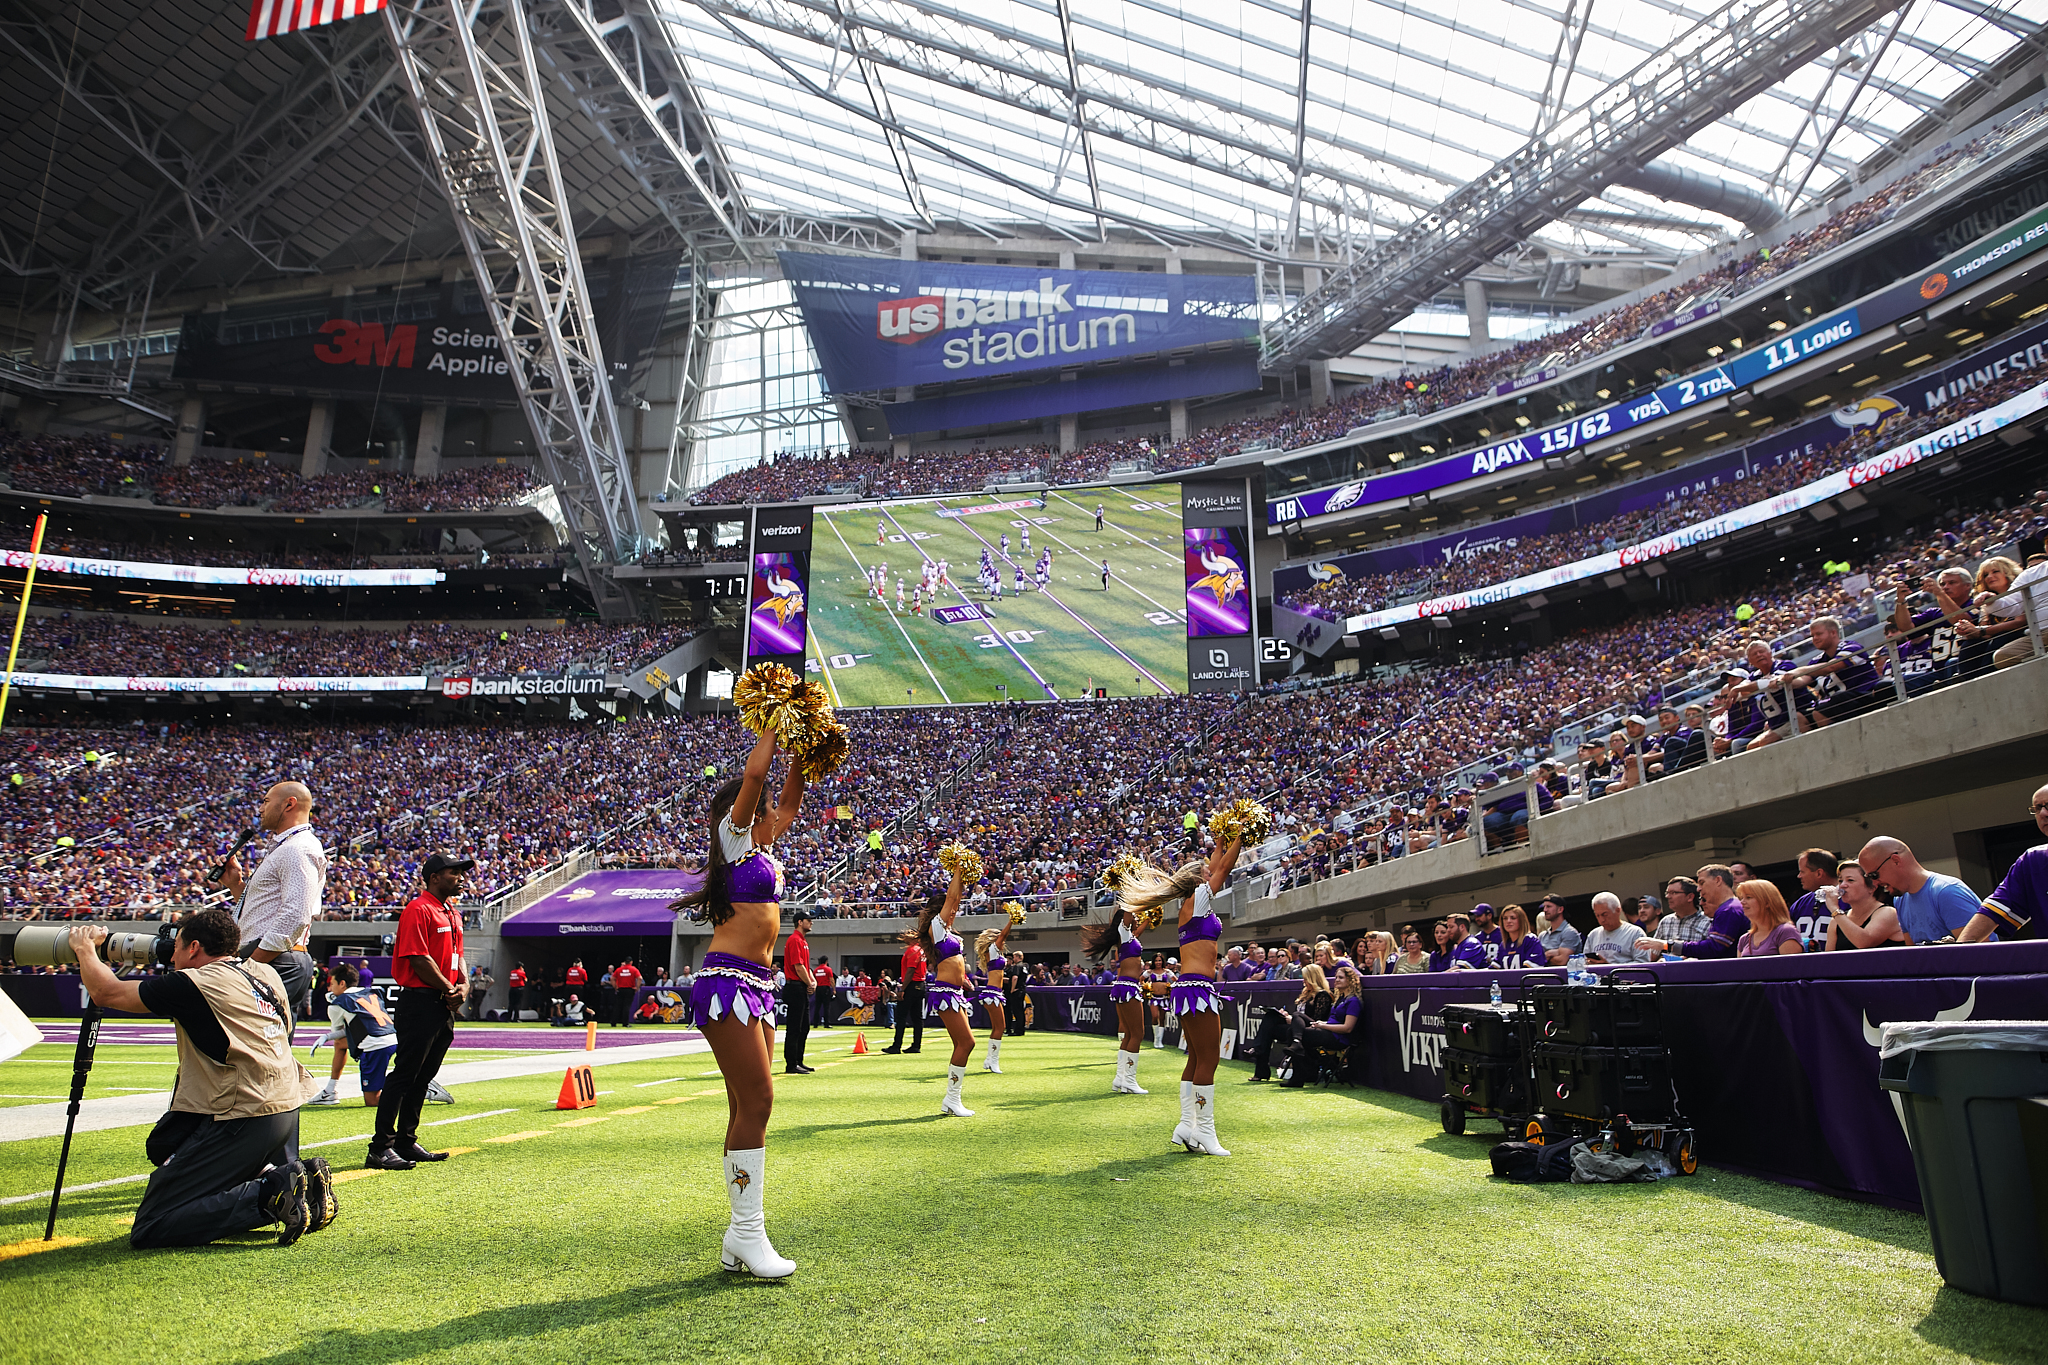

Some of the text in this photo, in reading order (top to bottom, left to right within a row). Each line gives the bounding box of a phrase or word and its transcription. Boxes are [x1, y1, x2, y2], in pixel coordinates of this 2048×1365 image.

[1952, 236, 2023, 279] THOMSON
[1674, 311, 1695, 327] MOSS
[313, 319, 418, 368] 3M
[432, 326, 535, 350] Sciene.
[943, 314, 1136, 369] stadium
[1512, 373, 1540, 390] RASHAD
[1472, 320, 1852, 474] AJAY 15/62 YDS 2 TDS 11 LONG
[1847, 420, 1983, 488] Coors LIGHT
[1666, 443, 1814, 501] HOME OF THE
[1186, 495, 1241, 509] Mystic LAKE
[1276, 500, 1297, 522] RB
[762, 525, 801, 536] verizon
[1617, 520, 1728, 567] Coors LIGHT
[6, 550, 122, 577] Coors LIGHT
[247, 568, 344, 586] Coors LIGHT
[705, 577, 745, 597] 7:17
[1417, 585, 1512, 618] Coors LIGHT
[963, 605, 980, 620] 10
[1263, 639, 1290, 660] 25
[127, 677, 204, 691] Coors LIGHT
[278, 677, 351, 691] Coors LIGHT
[1192, 671, 1214, 680] LAND
[1214, 670, 1250, 680] O'LAKES
[1559, 734, 1581, 748] 124
[1593, 944, 1622, 955] VIKINGS
[1502, 953, 1521, 969] 14
[1068, 991, 1101, 1024] VIKINGS
[574, 1067, 595, 1102] 10
